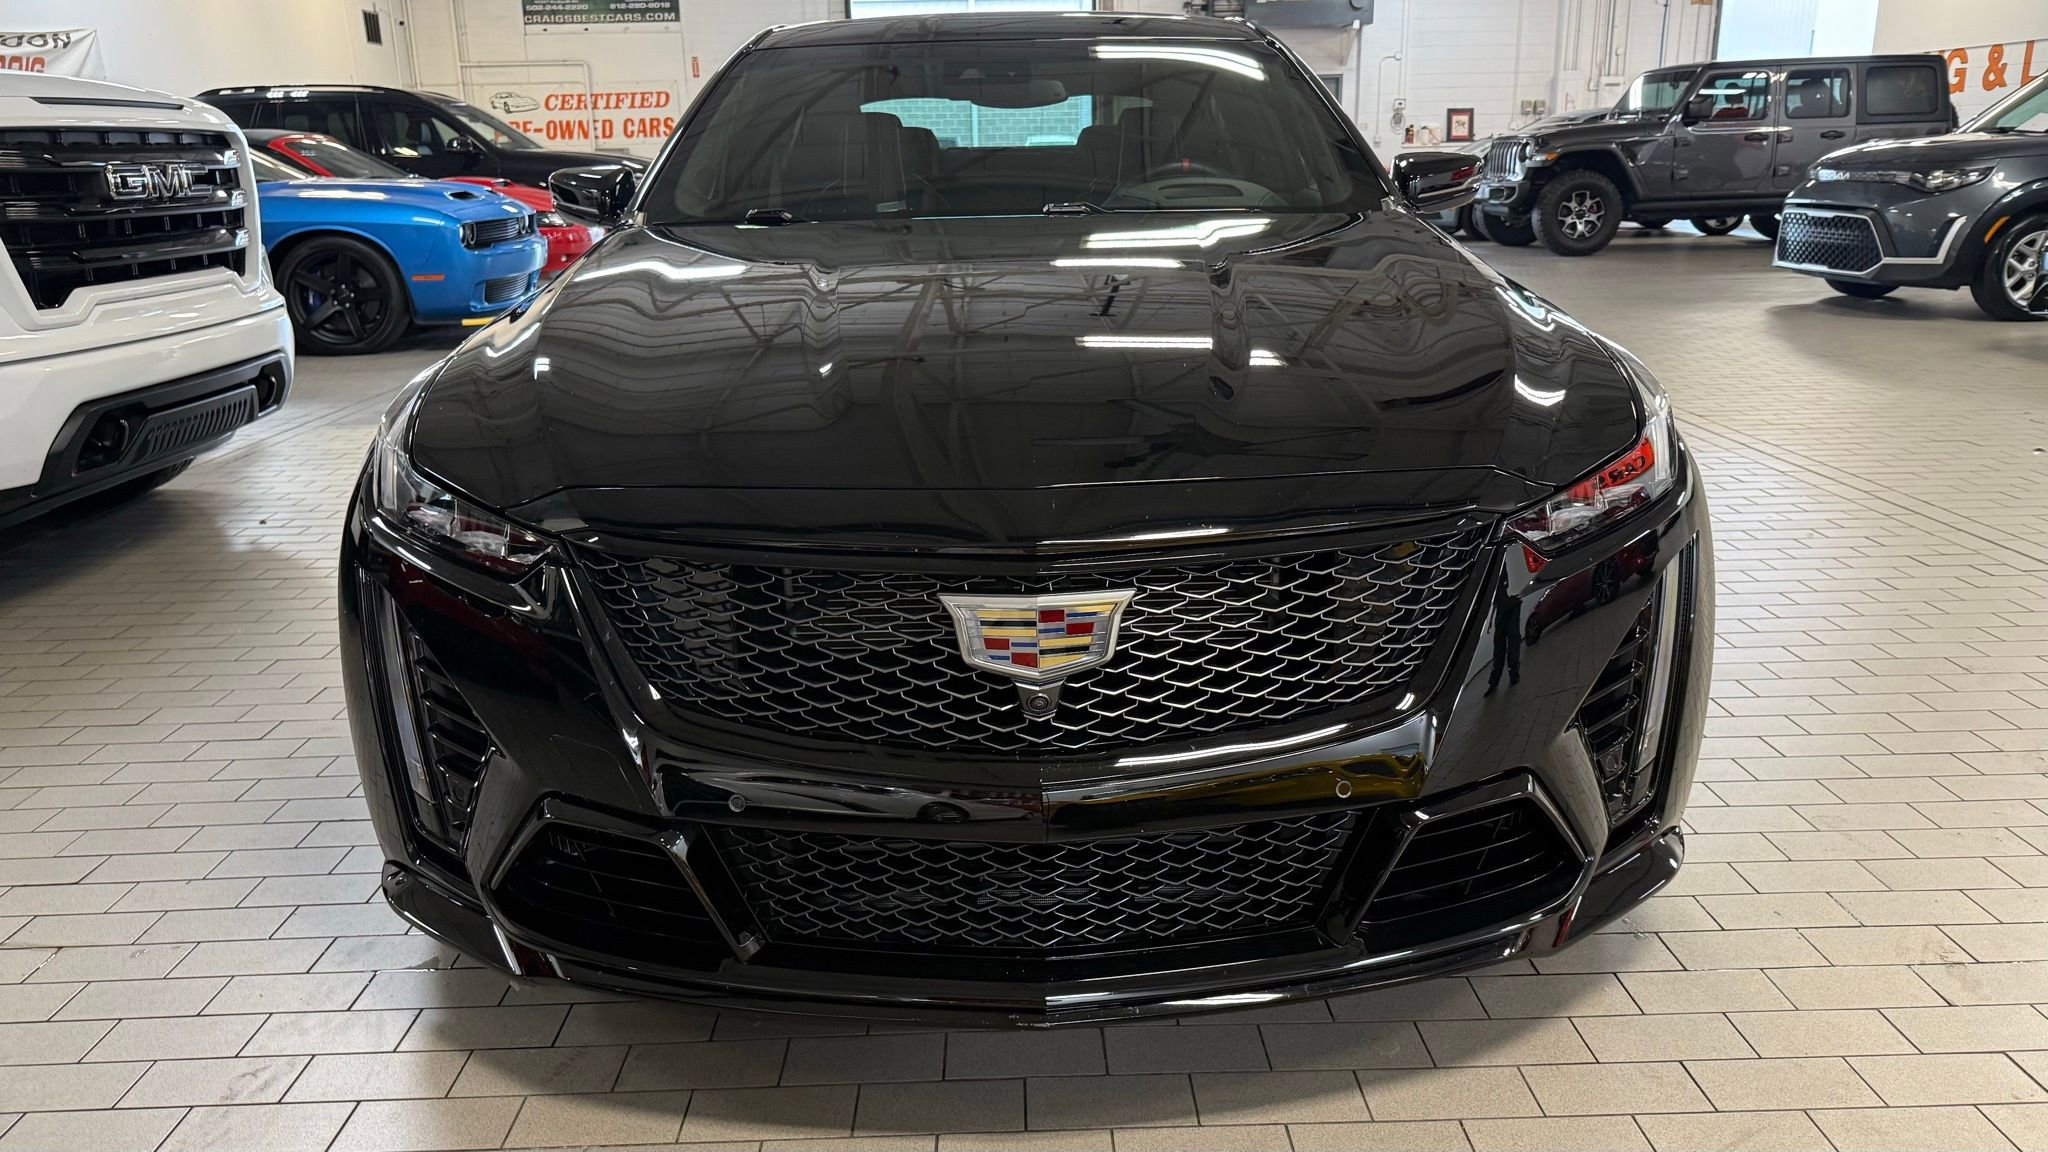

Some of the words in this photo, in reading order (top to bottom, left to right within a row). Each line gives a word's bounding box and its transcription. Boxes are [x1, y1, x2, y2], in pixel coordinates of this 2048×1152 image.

[524, 12, 676, 24] CRAIGSBESTCARS.COM
[1945, 48, 1968, 94] G
[1982, 44, 2008, 91] &
[544, 91, 671, 111] CERTIFIED
[623, 117, 675, 138] CARS
[105, 164, 212, 200] GMC
